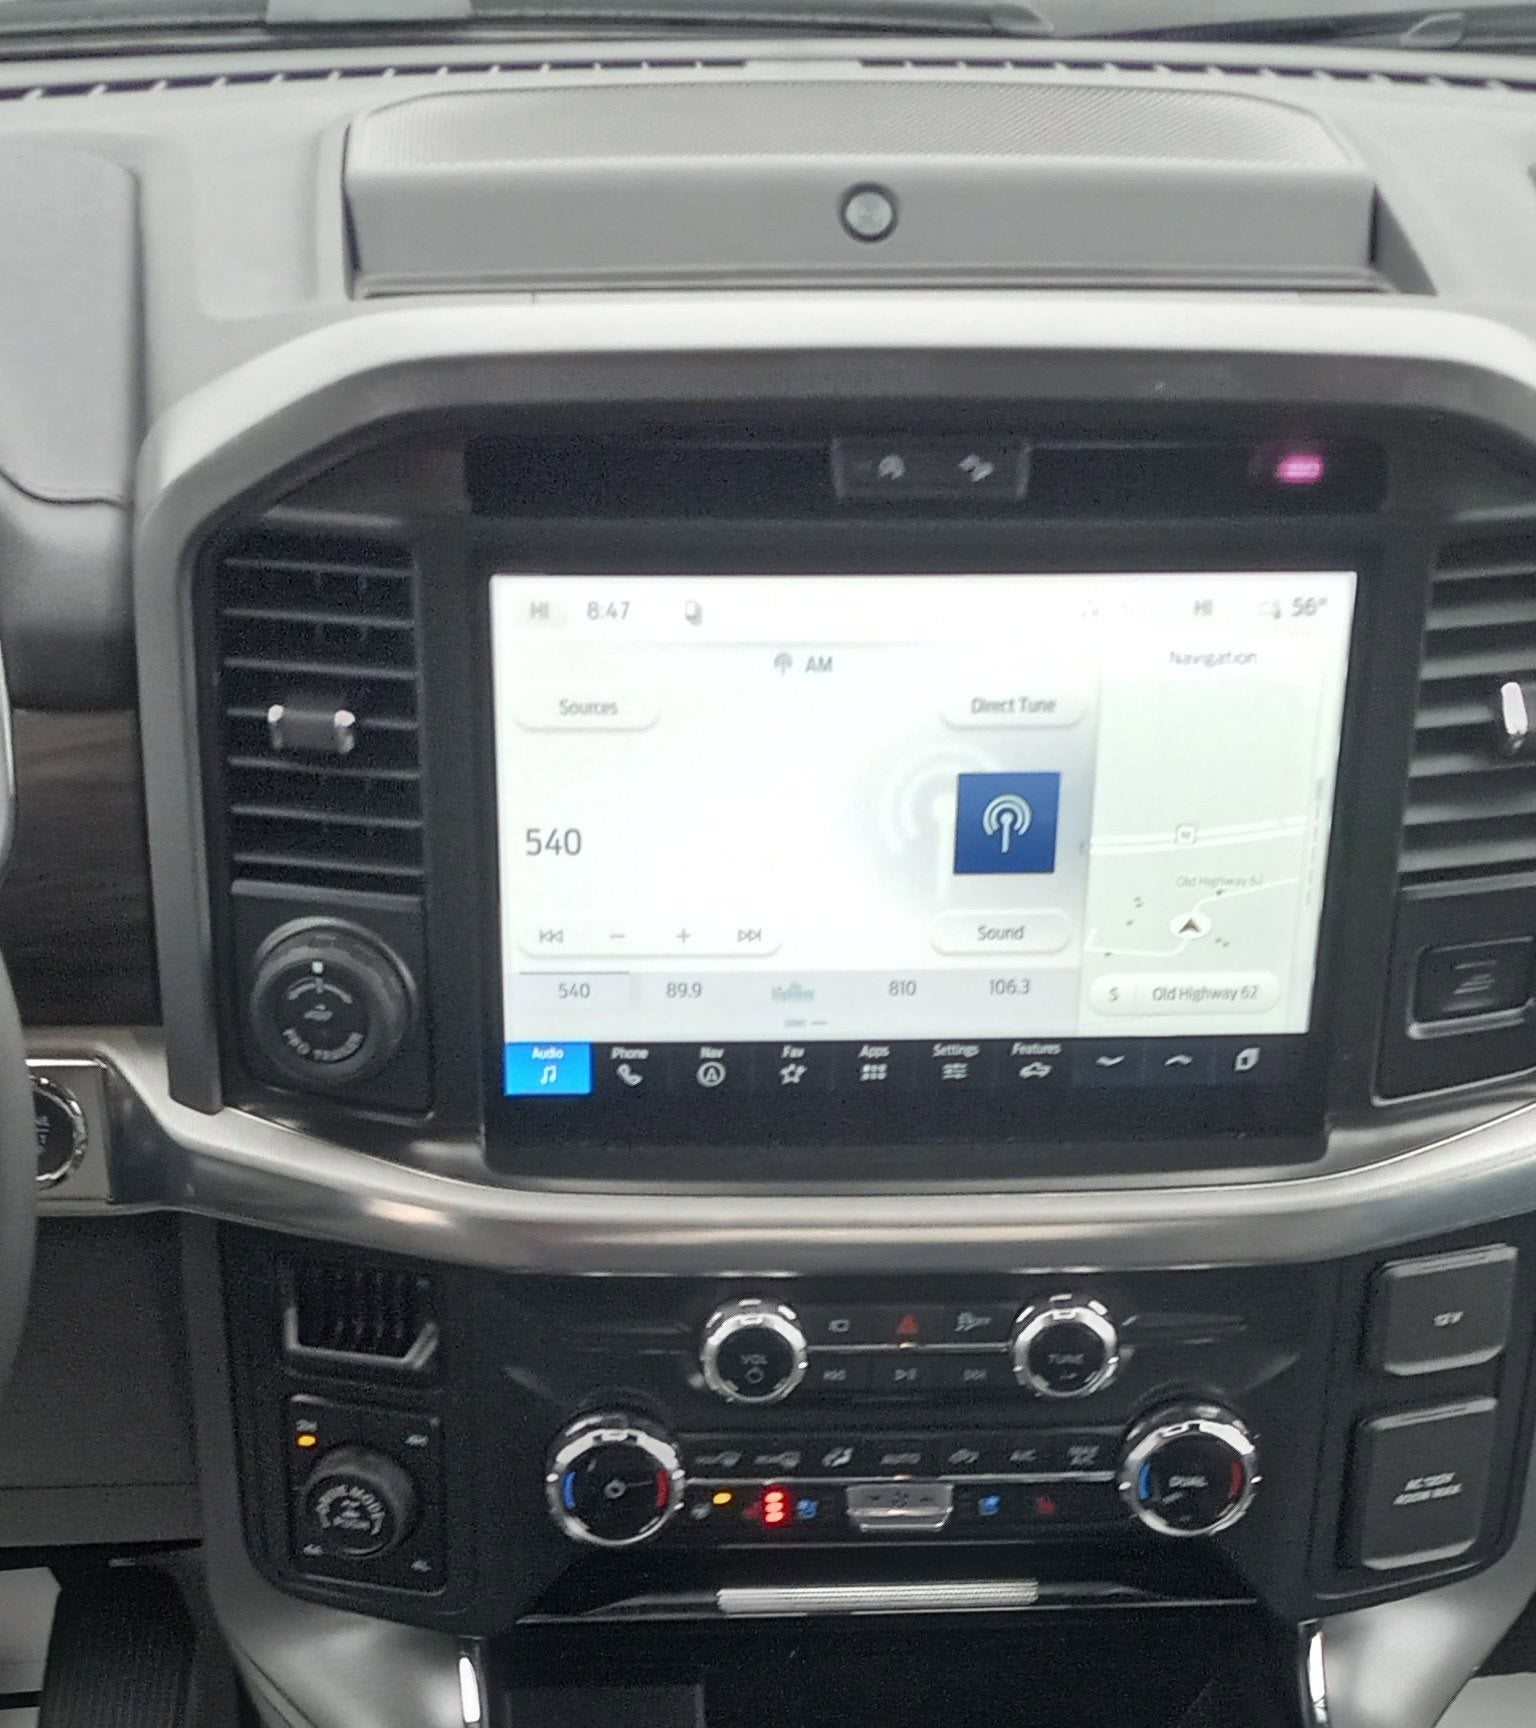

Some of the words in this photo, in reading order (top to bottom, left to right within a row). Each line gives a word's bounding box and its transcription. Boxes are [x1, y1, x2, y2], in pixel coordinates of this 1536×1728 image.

[586, 600, 631, 620] 8:47
[805, 656, 833, 674] AM
[1169, 650, 1257, 667] Navigation
[559, 699, 618, 717] Sources
[971, 697, 1015, 714] Direct
[1019, 697, 1057, 714] Tune
[524, 828, 583, 857] 540
[976, 925, 1024, 941] Sound
[558, 982, 591, 999] 540
[666, 982, 703, 999] 89.9
[888, 980, 917, 997] 810
[988, 978, 1030, 995] 106.3
[1152, 985, 1178, 1002] Old
[1179, 985, 1238, 1005] Highway
[1240, 983, 1260, 1000] 62
[531, 1046, 565, 1060] Audio
[610, 1046, 650, 1060] Phone
[700, 1046, 724, 1060] Nav
[859, 1044, 890, 1060] Apps
[932, 1043, 980, 1058] Settings
[1011, 1042, 1062, 1056] Features
